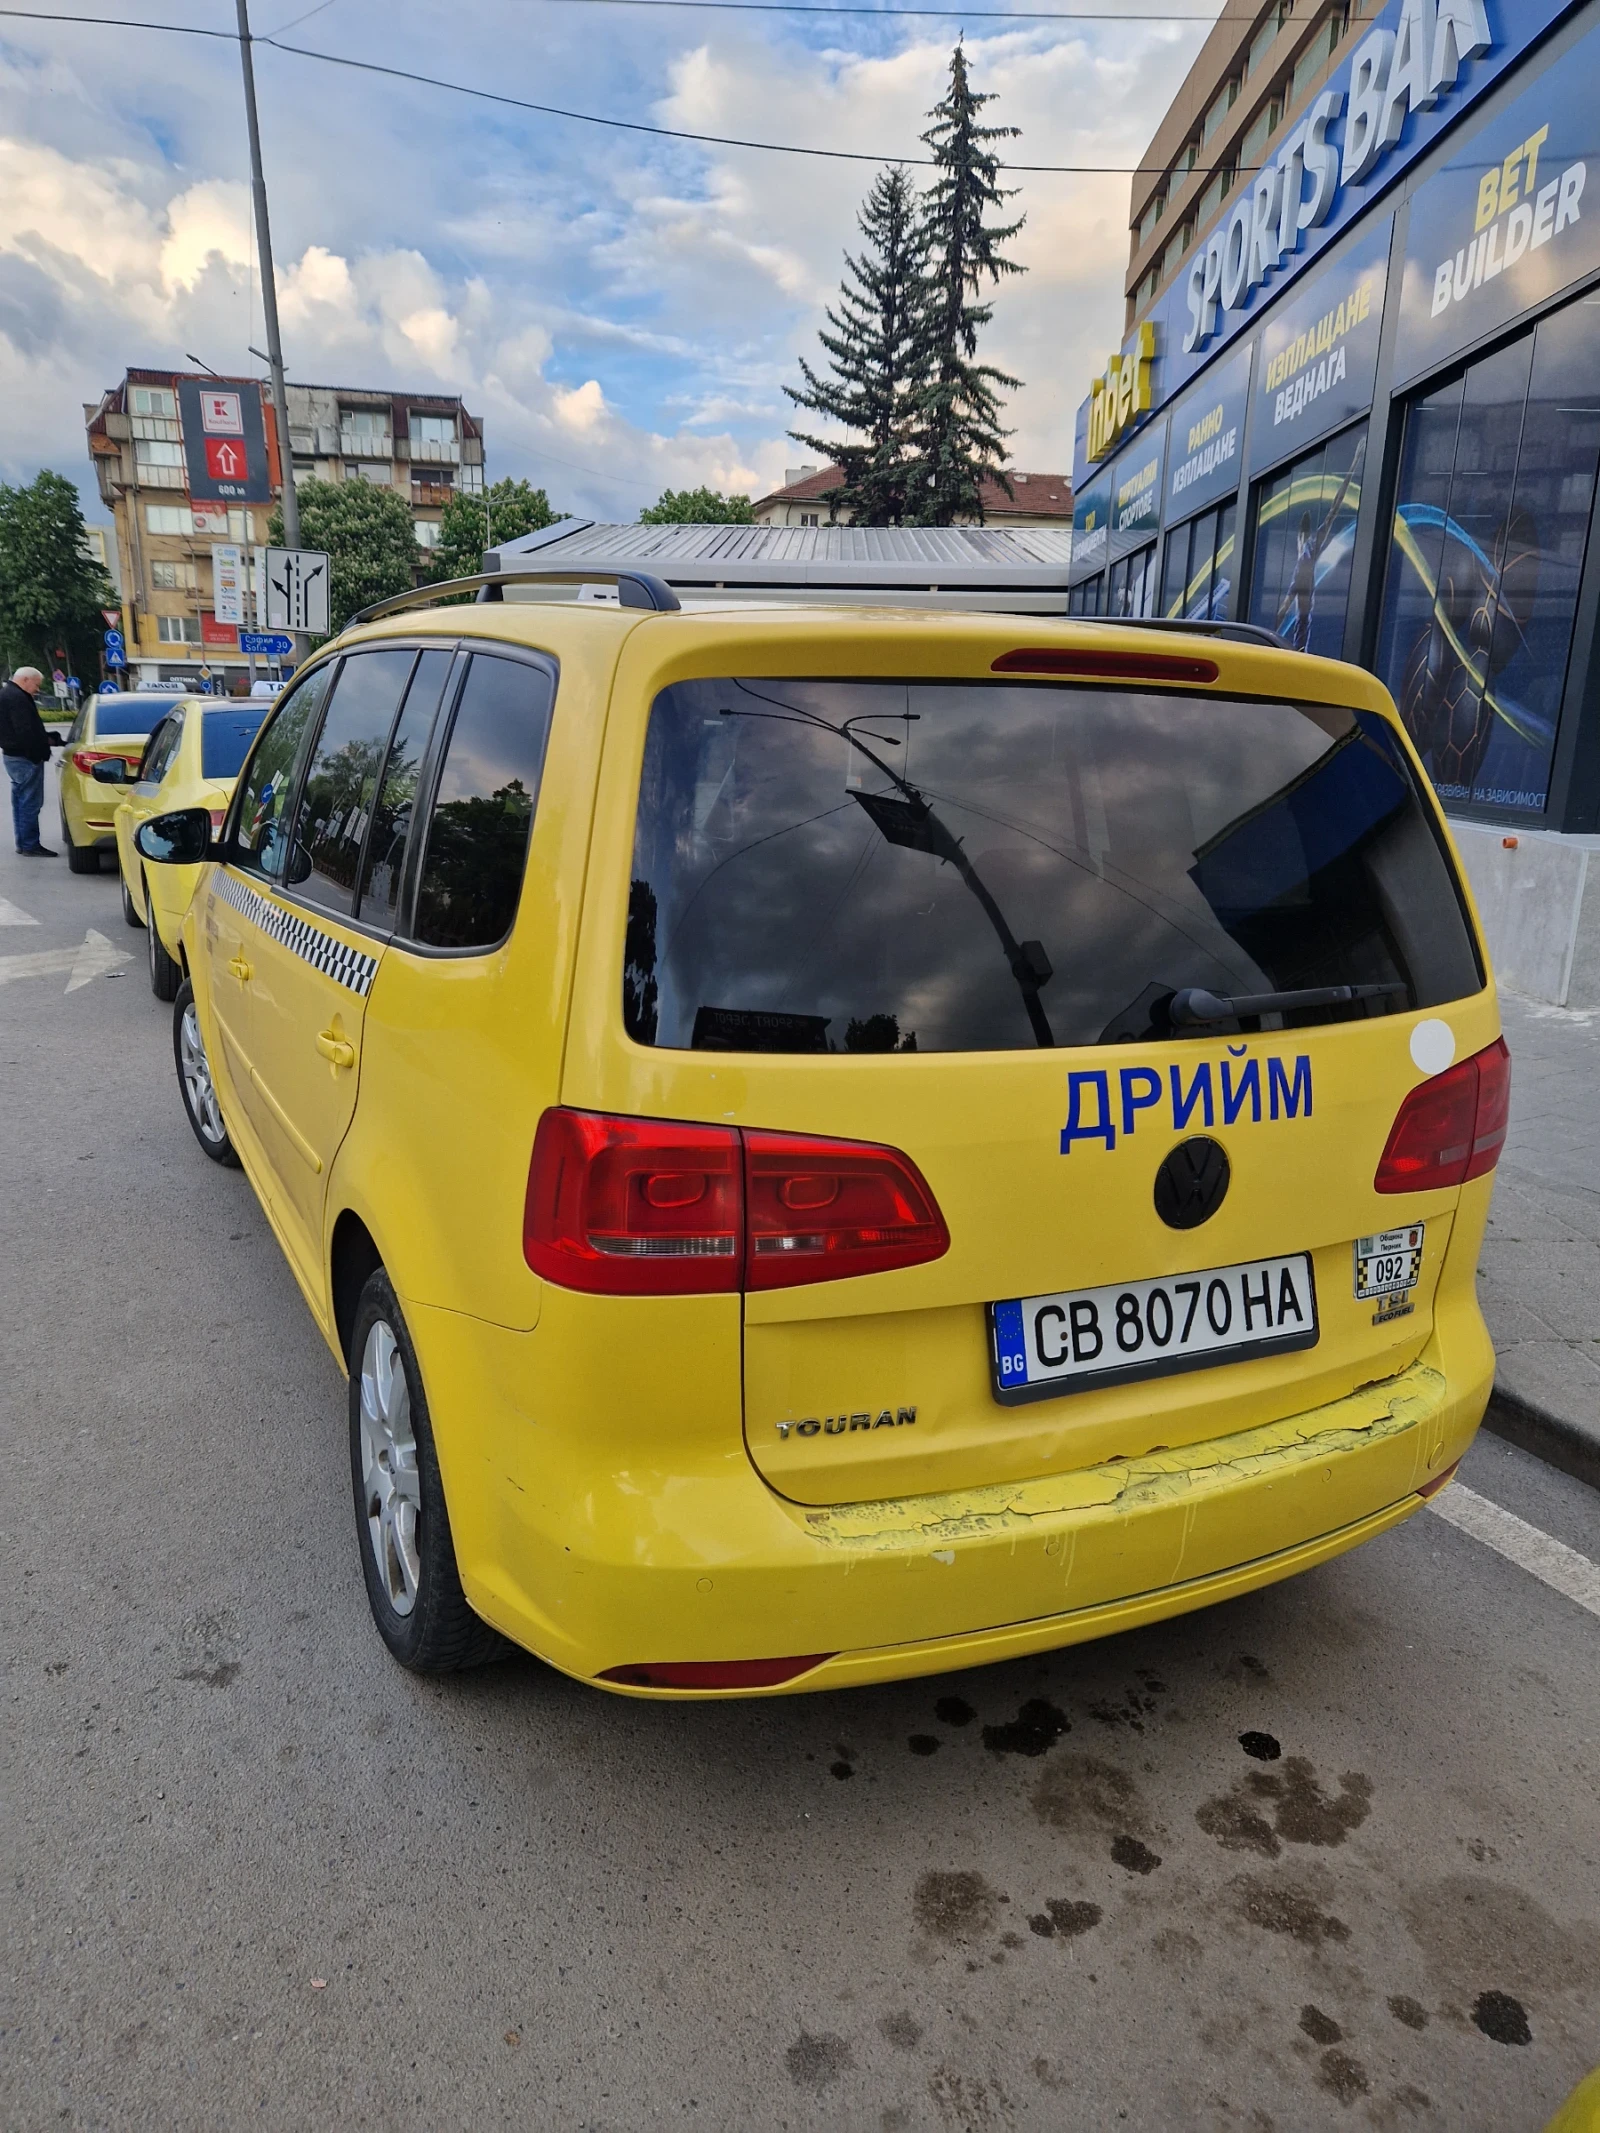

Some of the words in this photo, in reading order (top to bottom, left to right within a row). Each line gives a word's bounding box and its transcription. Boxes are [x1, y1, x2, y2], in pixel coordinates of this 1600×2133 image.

[1474, 123, 1549, 233] BET
[1430, 161, 1586, 319] BUILDER
[1266, 279, 1372, 393] ИЗПЛАЩАНЕ
[1086, 320, 1155, 463] inbet
[1274, 346, 1346, 426] ВЕДНАГА
[1187, 404, 1224, 454] РАННО
[1172, 427, 1236, 495] ИЗПЛАЩАНЕ
[218, 485, 236, 495] 600
[1119, 489, 1153, 532] СПОРТОВЕ
[245, 635, 274, 644] София
[246, 644, 268, 652] Sofia
[276, 641, 288, 649] 30
[1473, 788, 1485, 800] НА
[1486, 788, 1547, 808] ЗАВИСИМОСТ
[1059, 1044, 1313, 1155] ДРИЙМ
[1380, 1233, 1403, 1242] Община
[1381, 1243, 1402, 1252] Перник
[1376, 1256, 1403, 1283] 092
[1116, 1278, 1232, 1352] 8070
[1376, 1290, 1409, 1312] TSI
[1002, 1353, 1024, 1375] BG
[775, 1406, 918, 1440] TOURAN
